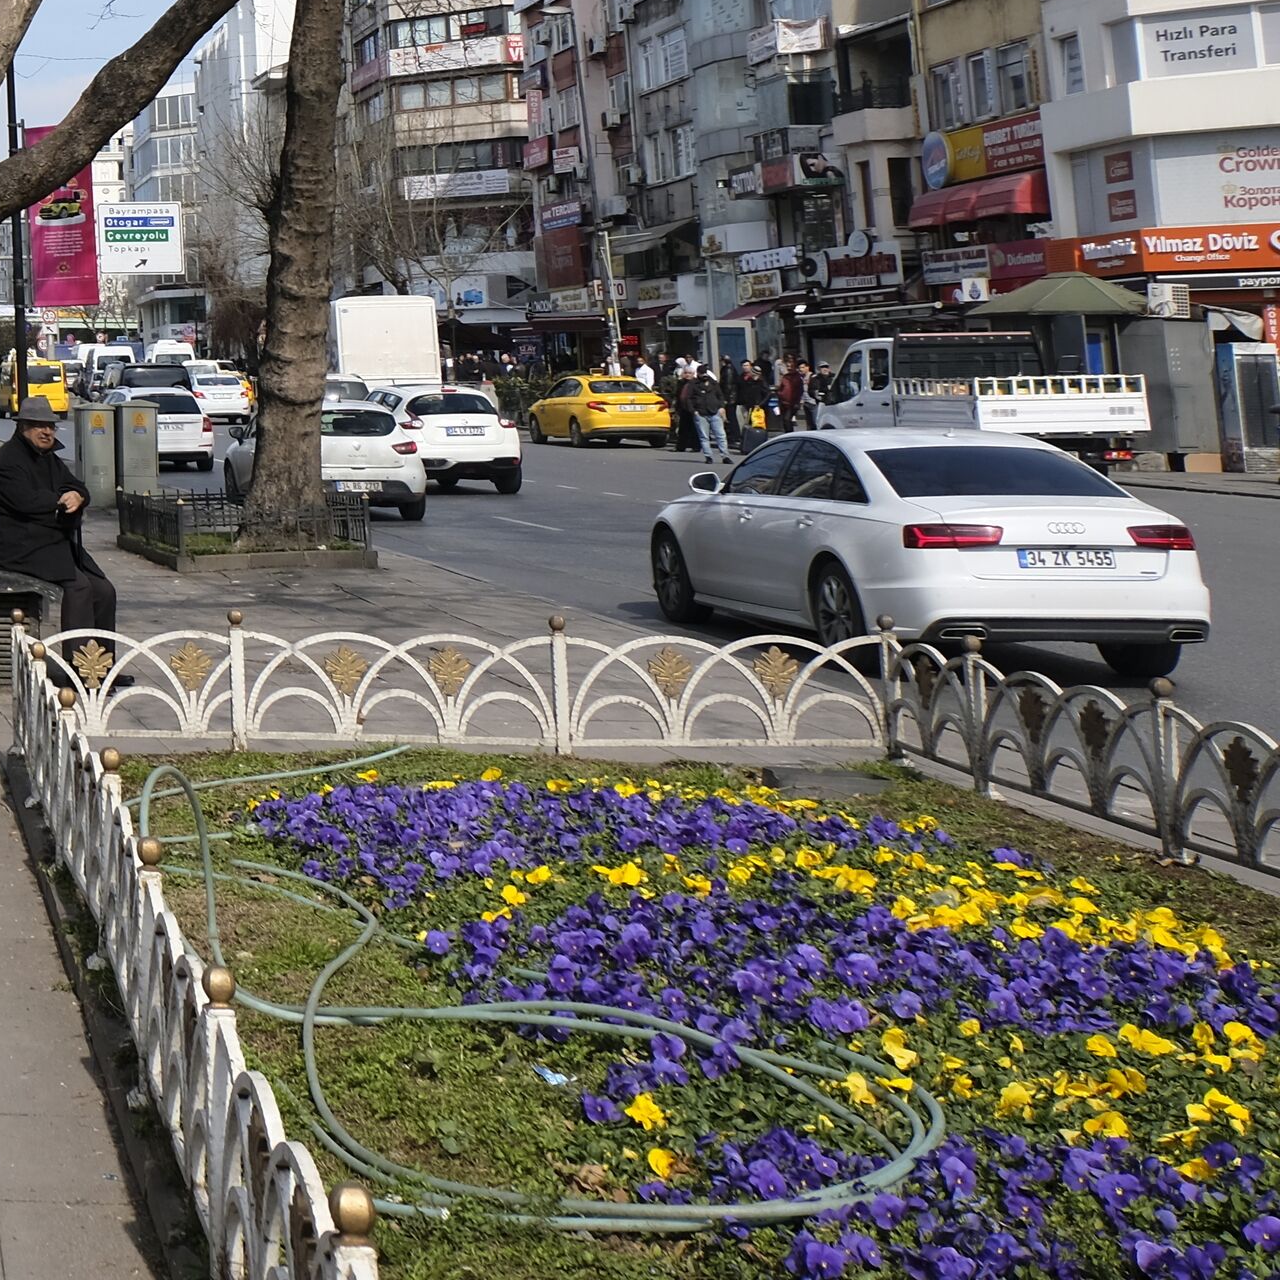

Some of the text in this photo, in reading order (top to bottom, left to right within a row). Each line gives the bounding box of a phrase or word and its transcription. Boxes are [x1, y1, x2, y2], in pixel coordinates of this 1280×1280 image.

[1155, 23, 1238, 43] Hızlı Para
[1159, 42, 1238, 63] Transferi
[1218, 154, 1280, 174] Crow
[106, 218, 144, 228] Otogar
[107, 231, 167, 242] Çevreyolu
[1143, 231, 1260, 255] Yılmaz Döviz
[108, 245, 151, 254] Topkapı
[1174, 251, 1231, 263] Change Office
[1266, 304, 1278, 341] MONEY
[1027, 549, 1114, 566] 34 ZK 5455
